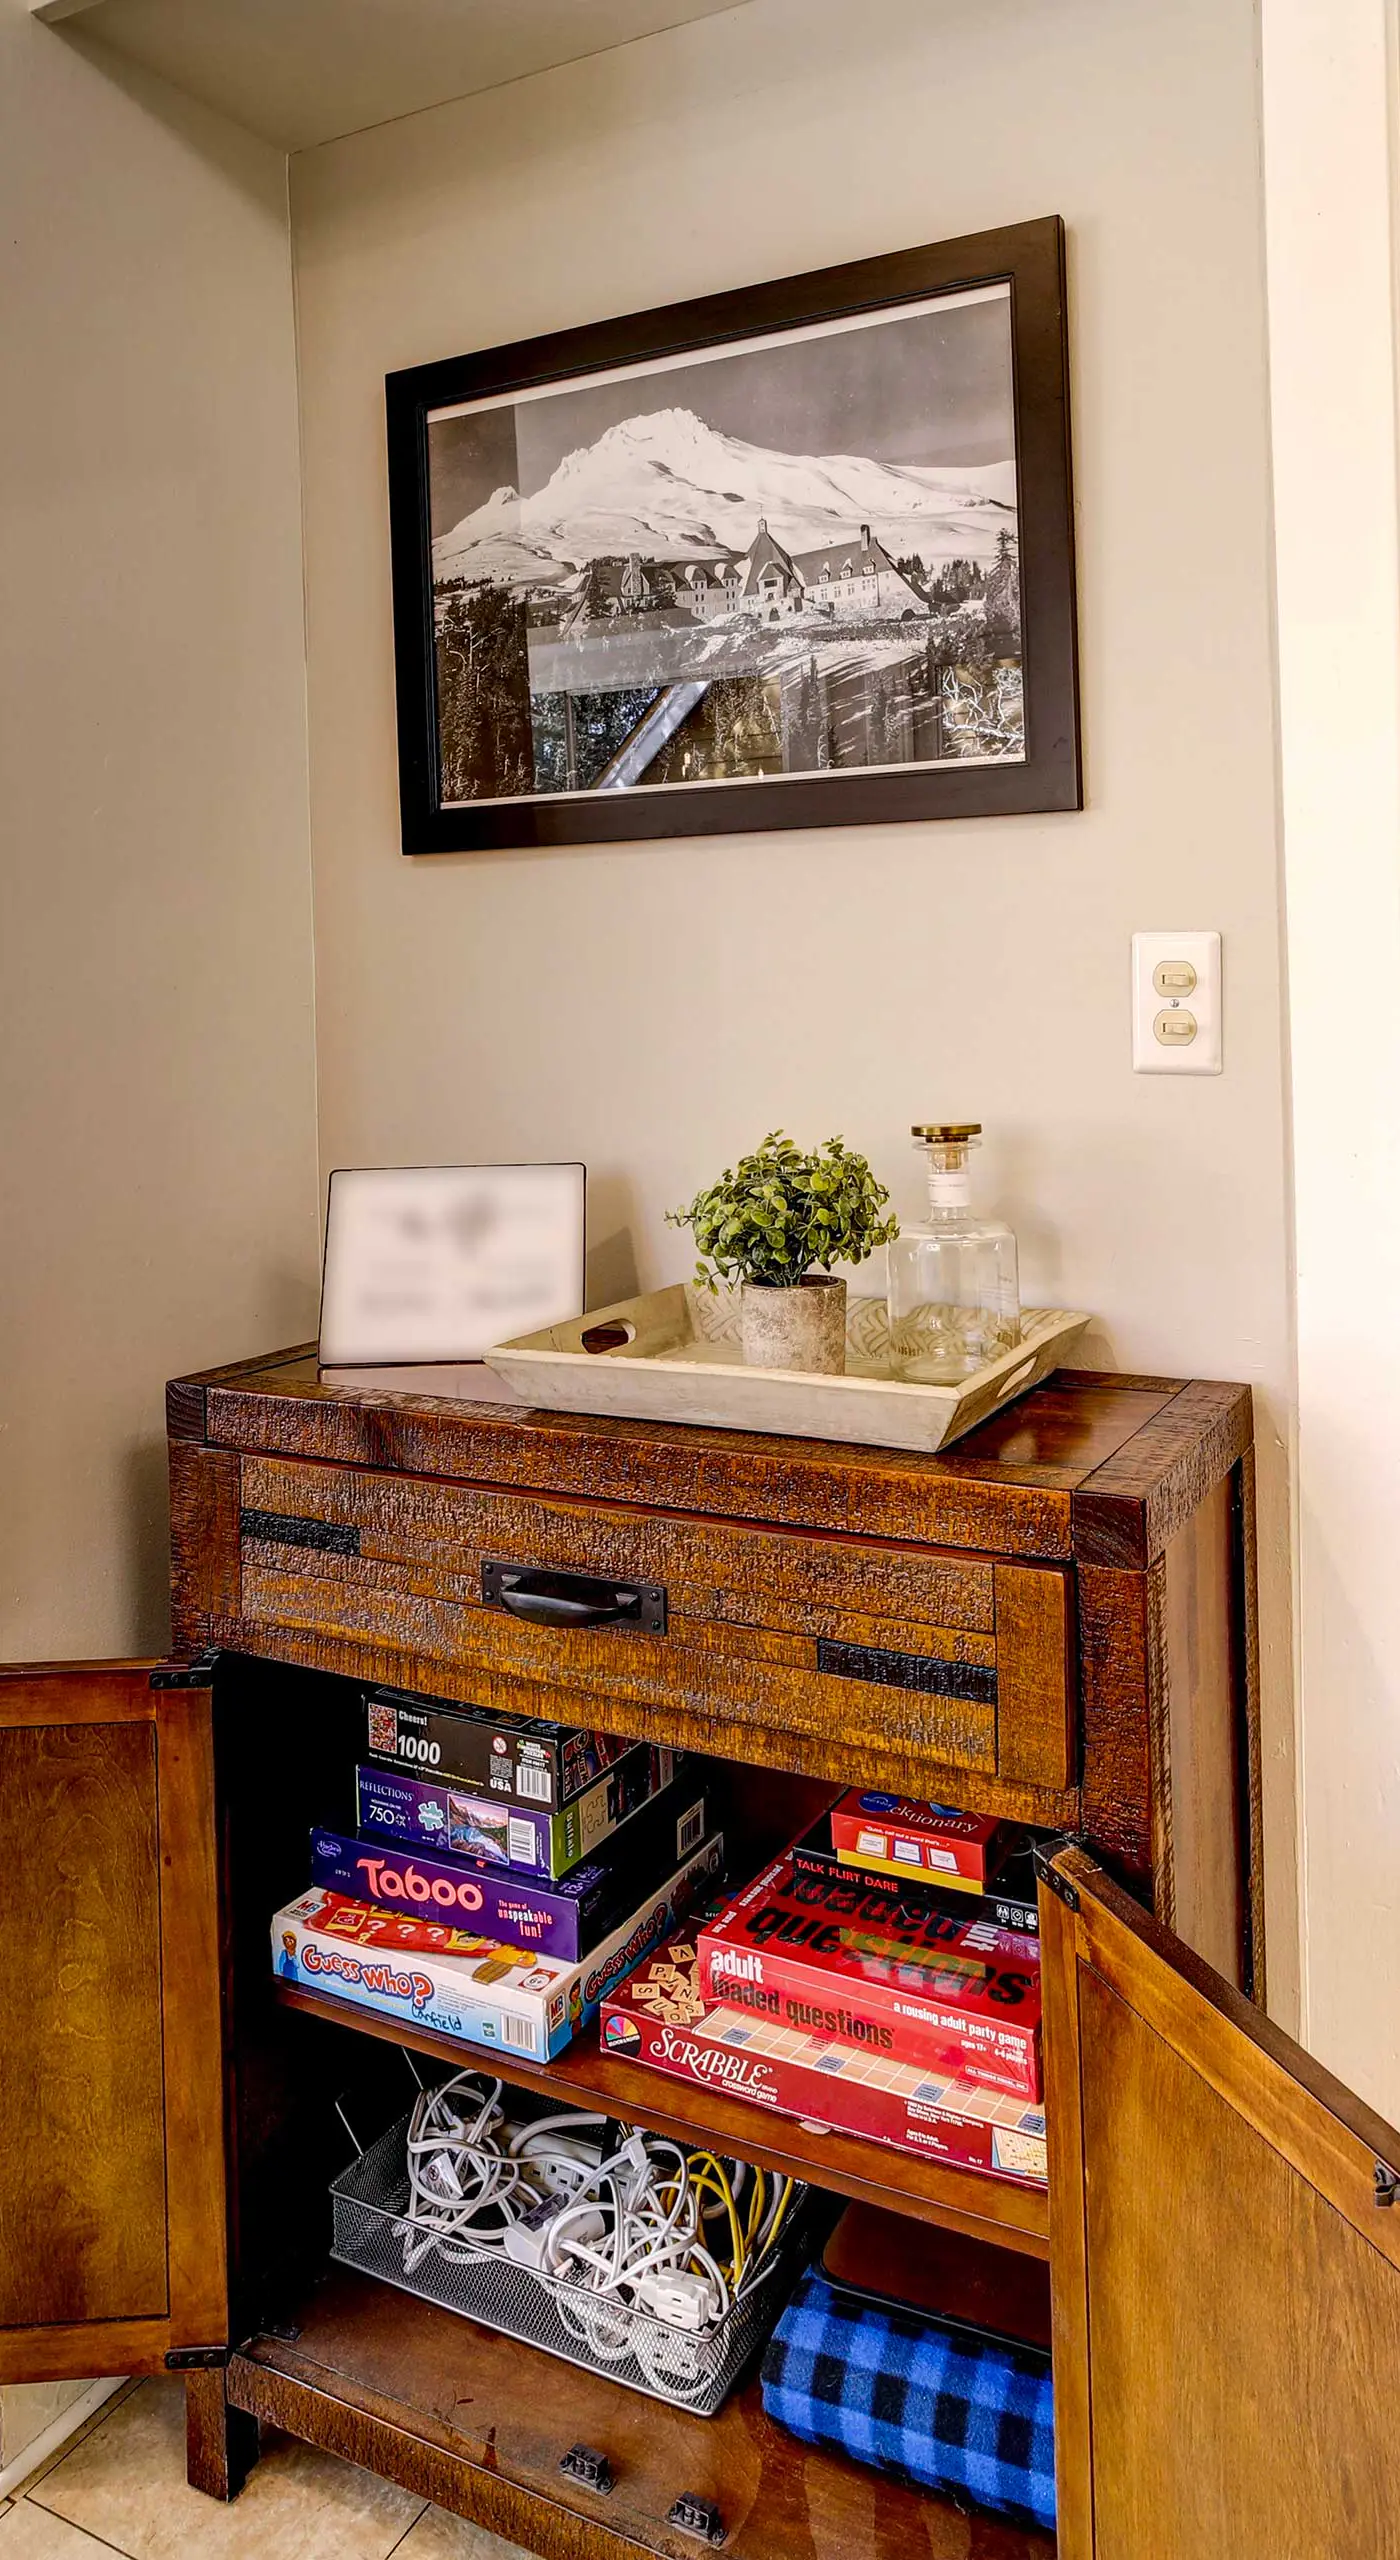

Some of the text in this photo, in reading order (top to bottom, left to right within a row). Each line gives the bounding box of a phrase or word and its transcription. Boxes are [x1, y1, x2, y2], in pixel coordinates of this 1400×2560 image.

[399, 1710, 428, 1726] Cheers!
[398, 1734, 442, 1765] 1000
[360, 1780, 413, 1801] REFLECTIONS
[489, 1780, 512, 1793] USA
[368, 1804, 395, 1825] 750
[887, 1805, 979, 1833] cktionary
[565, 1812, 575, 1858] Buffalo
[357, 1858, 484, 1911] Taboo
[797, 1858, 899, 1893] TALK FLIRT DARE
[296, 1900, 317, 1913] MB
[497, 1908, 553, 1926] unspeakable
[519, 1921, 543, 1938] fun!
[301, 1944, 361, 1982] Guess
[359, 1964, 435, 2008] Who?
[710, 1950, 764, 1984] adult
[712, 1970, 893, 2049] loaded questions
[893, 2002, 1028, 2050] a rousing adult party game
[649, 2027, 770, 2089] SCRABBLE
[960, 2039, 975, 2050] ages
[722, 2078, 778, 2103] crossword game
